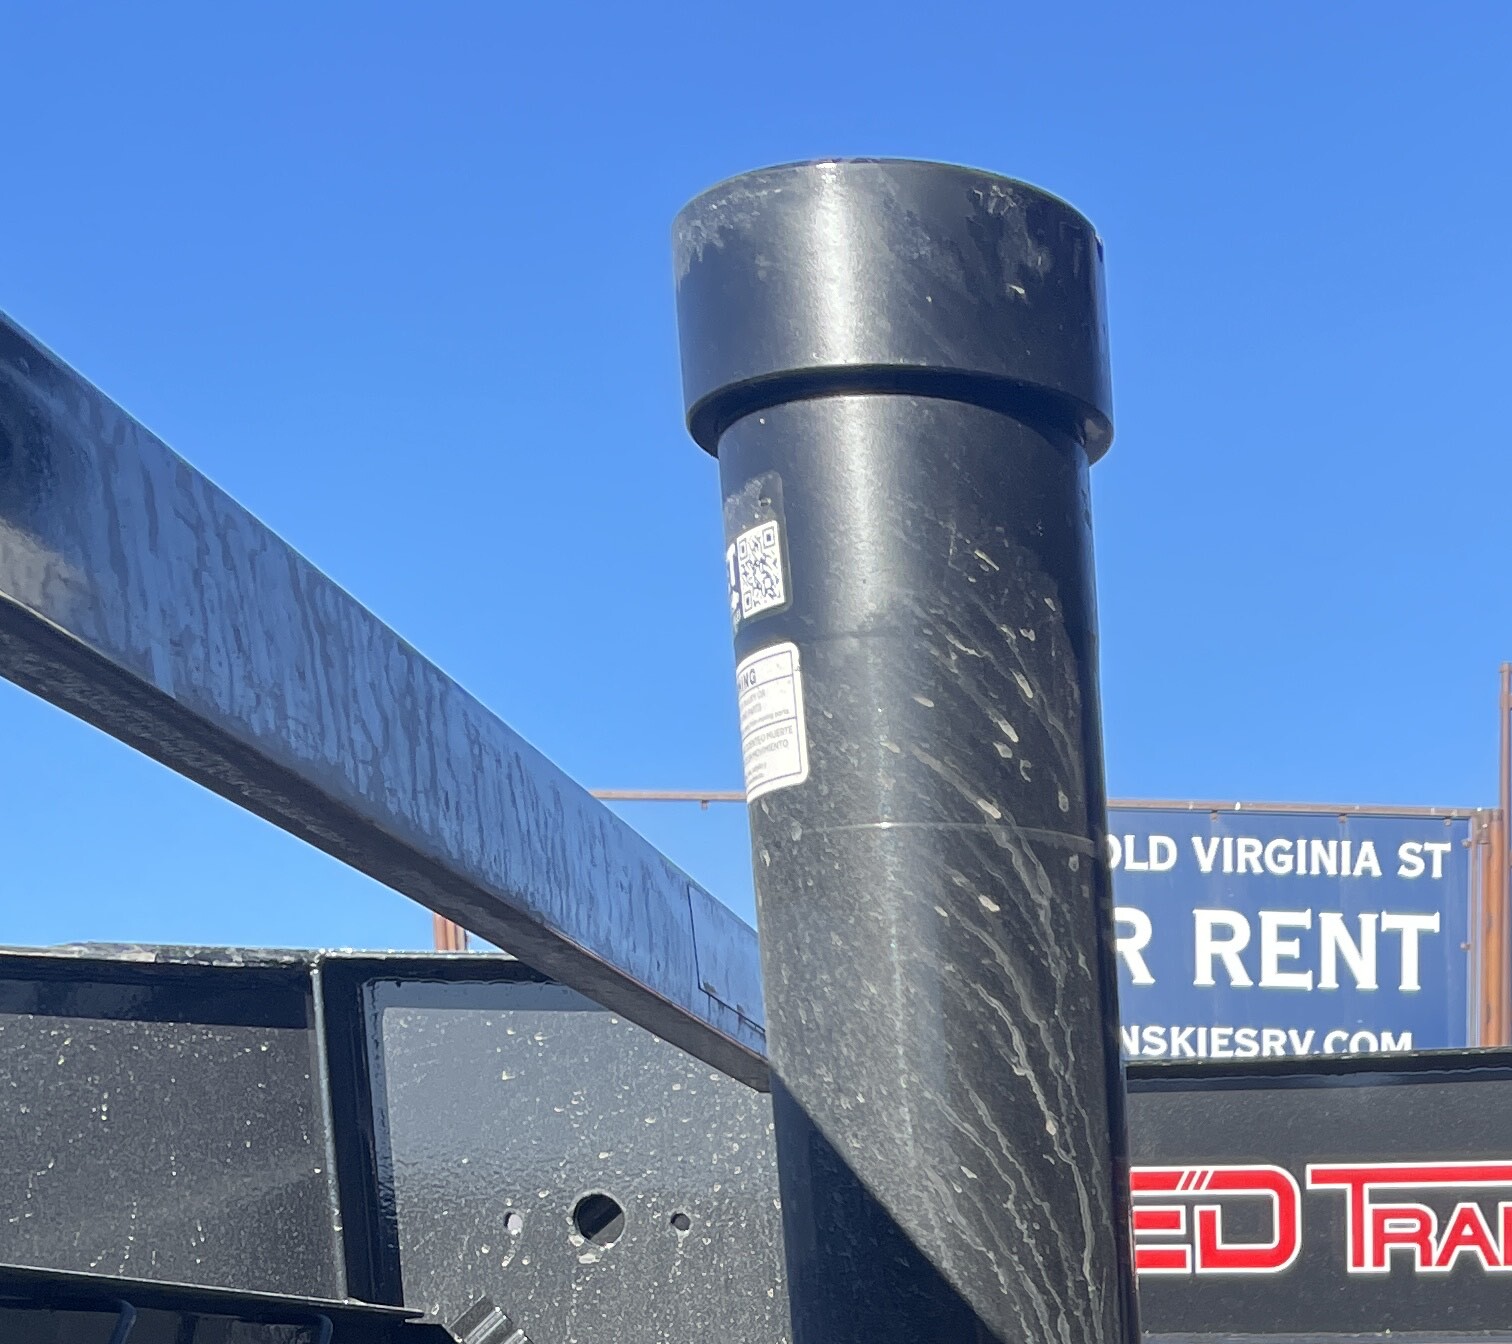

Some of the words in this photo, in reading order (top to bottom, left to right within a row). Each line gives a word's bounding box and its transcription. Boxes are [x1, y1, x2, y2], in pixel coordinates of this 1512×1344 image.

[1191, 836, 1382, 877] VIRGINIA
[1397, 842, 1452, 878] ST
[1192, 908, 1441, 991] RENT
